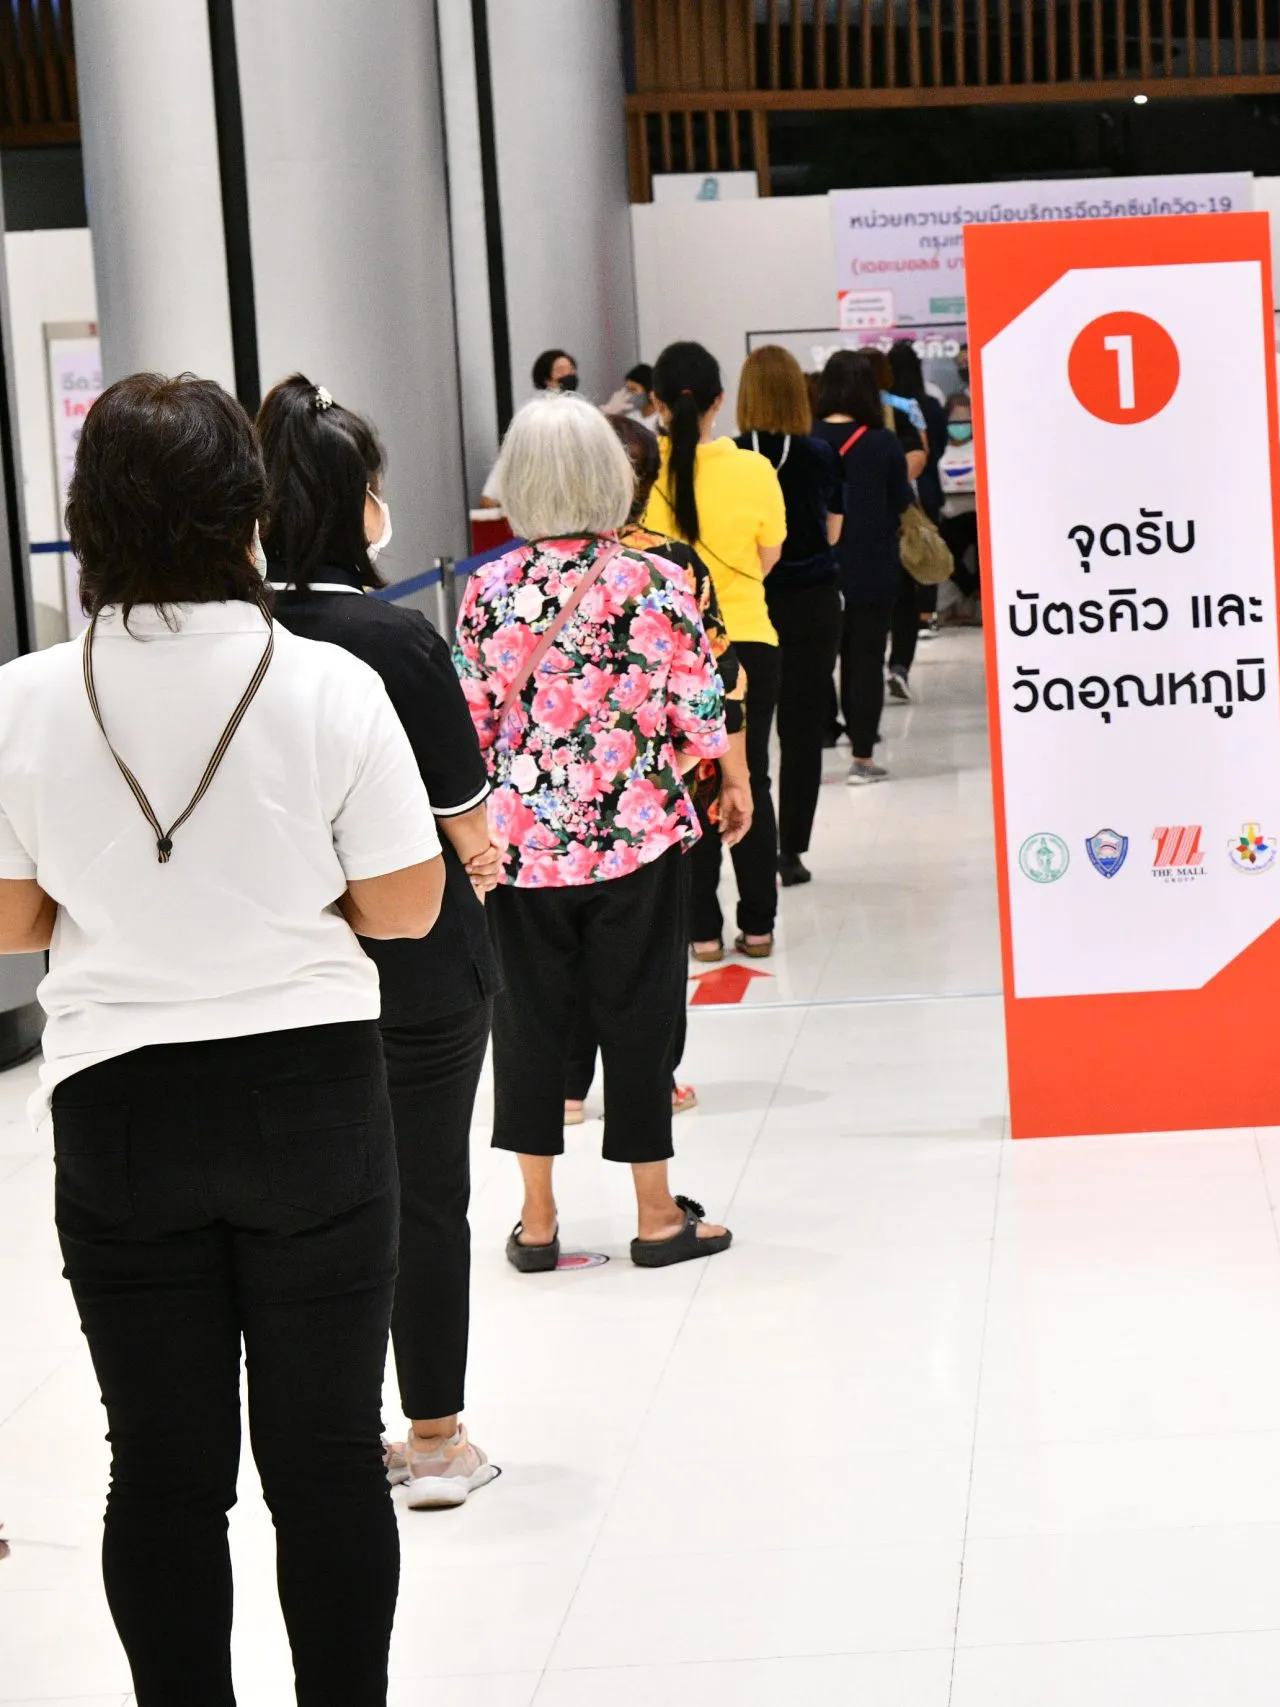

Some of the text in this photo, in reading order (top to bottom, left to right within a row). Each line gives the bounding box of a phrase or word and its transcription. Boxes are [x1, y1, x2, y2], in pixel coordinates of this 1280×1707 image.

[1104, 335, 1135, 409] 1
[1068, 508, 1196, 573] จุดรับ
[1009, 588, 1263, 637] บัตรคิว และ
[1012, 658, 1267, 724] วัดอุณหภูมิ
[1151, 867, 1208, 877] THE MALL
